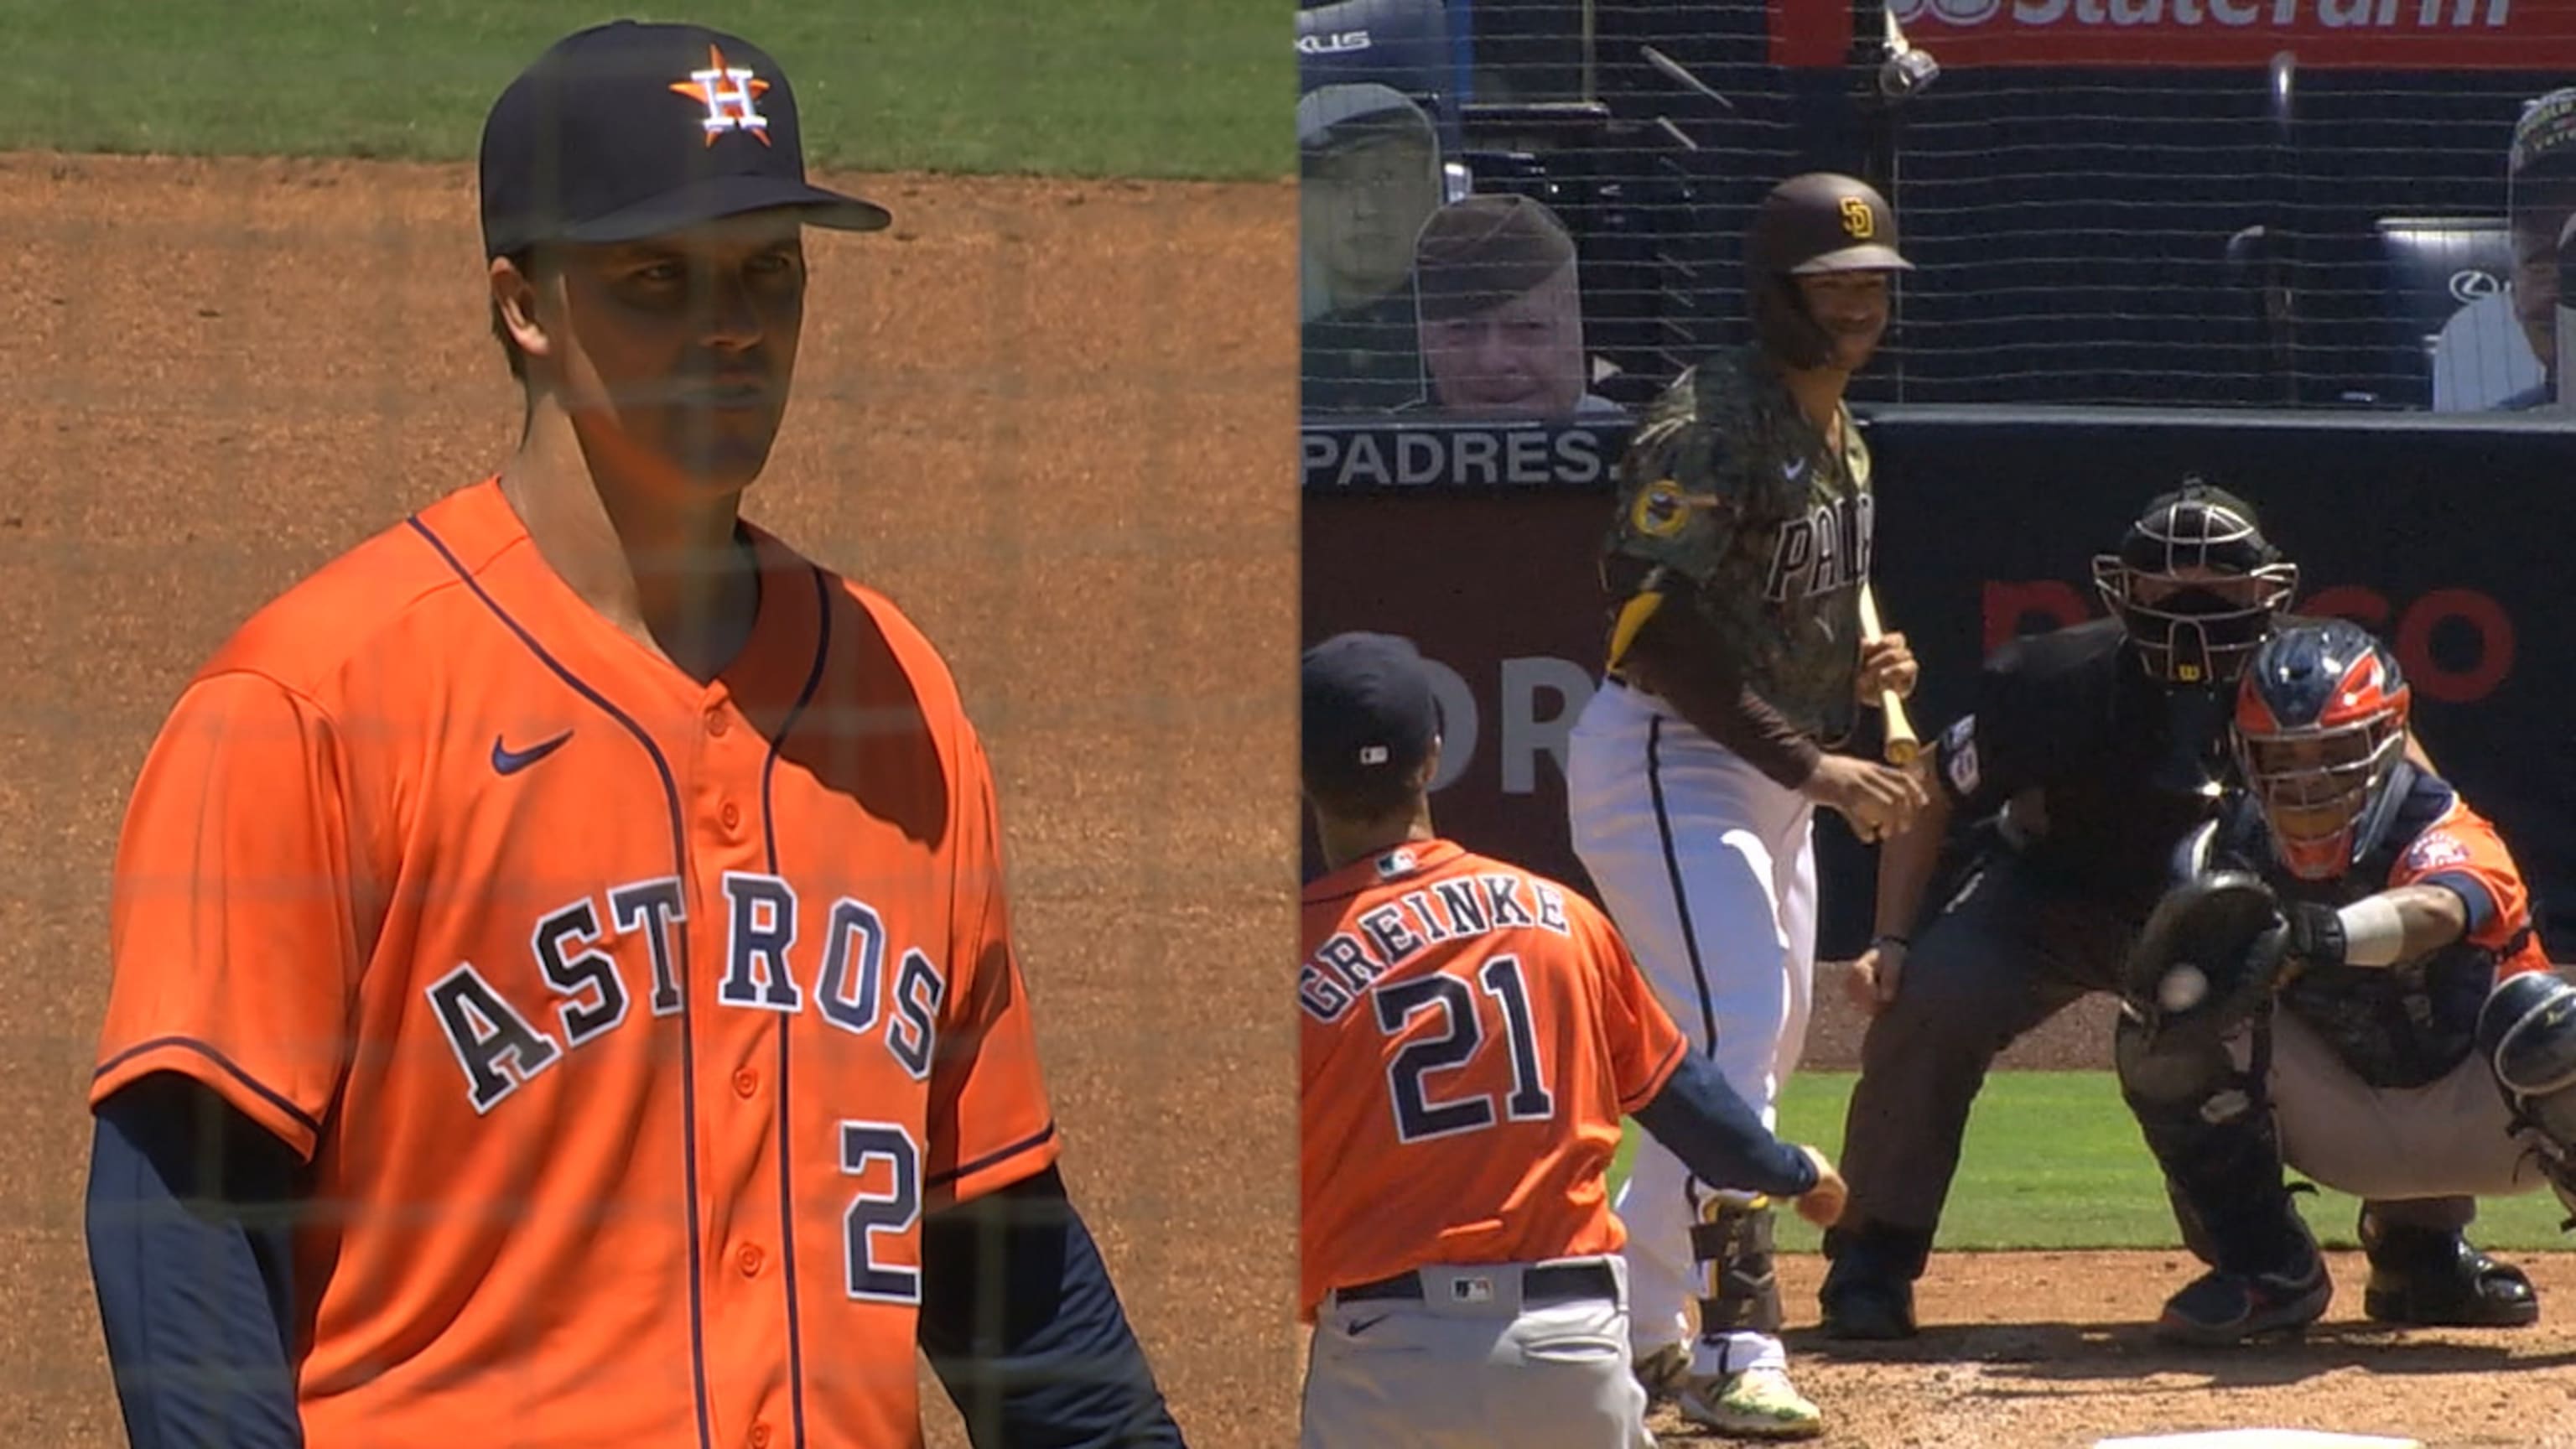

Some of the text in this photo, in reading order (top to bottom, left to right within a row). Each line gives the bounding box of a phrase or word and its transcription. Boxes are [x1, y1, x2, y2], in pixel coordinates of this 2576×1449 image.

[690, 67, 769, 132] H
[425, 870, 945, 1115] ASTROS
[1300, 873, 1572, 1024] GREINKE
[1372, 953, 1554, 1145] 21
[839, 1119, 922, 1305] 2
